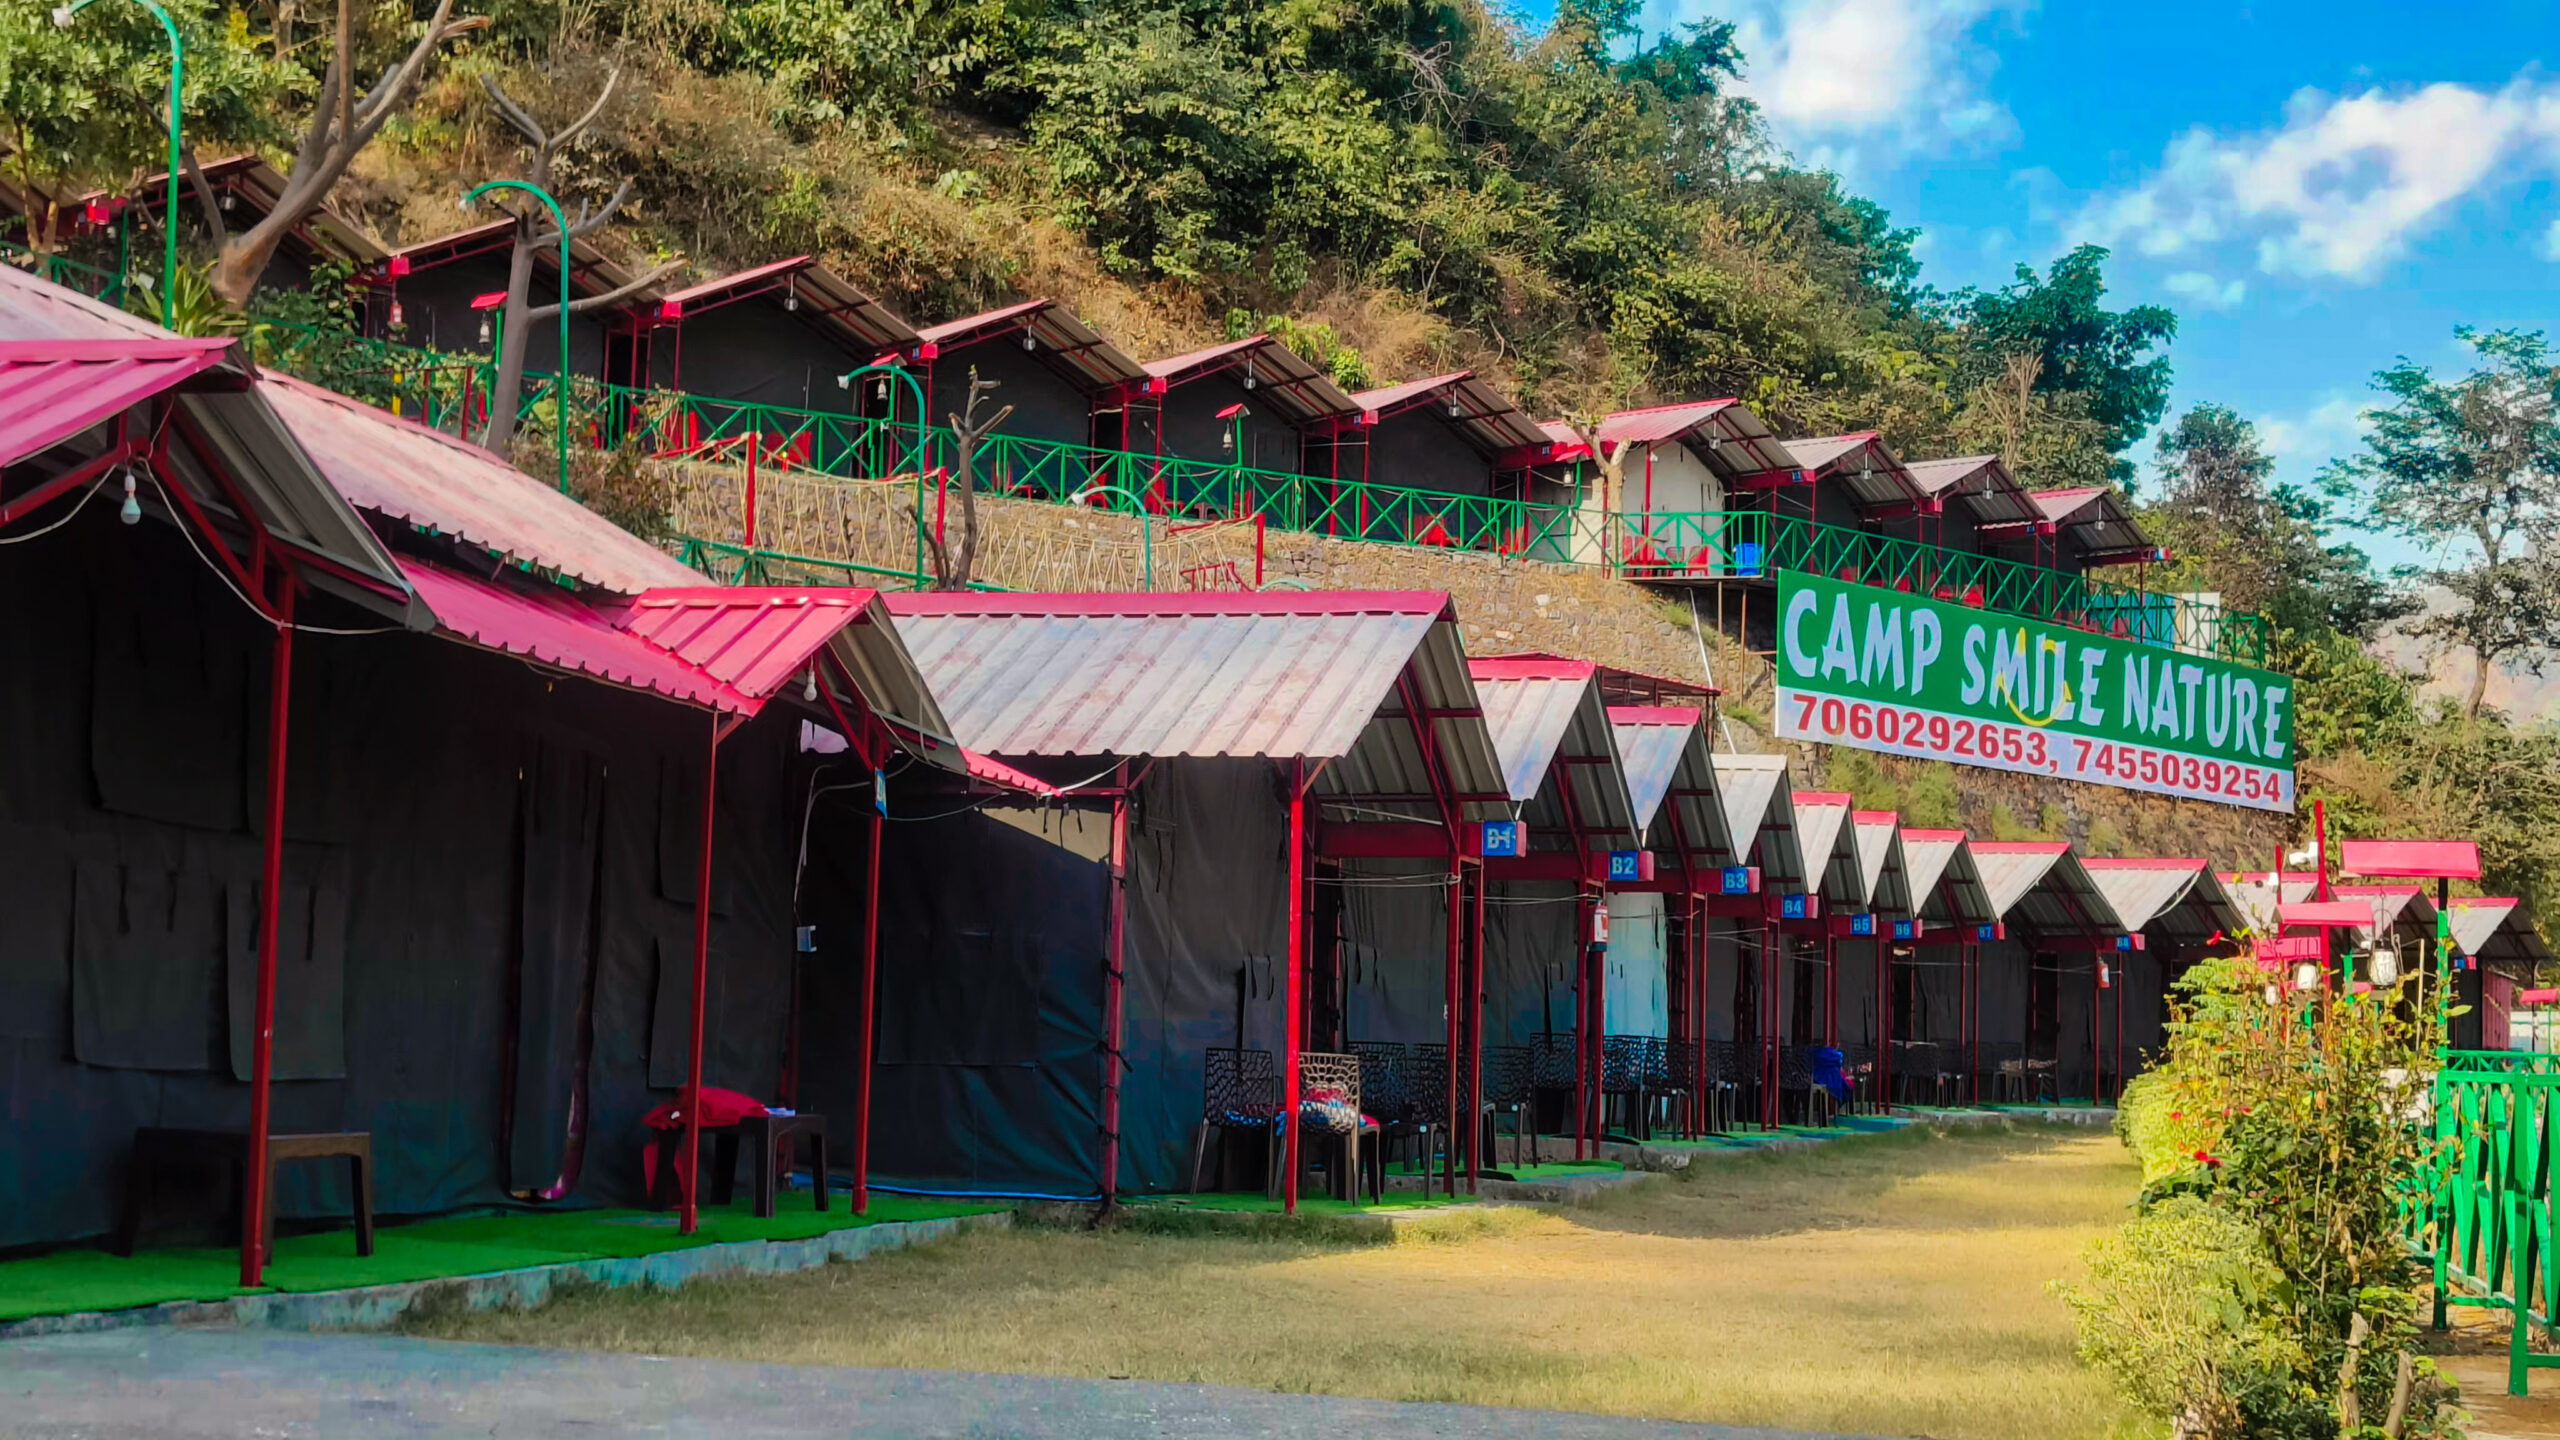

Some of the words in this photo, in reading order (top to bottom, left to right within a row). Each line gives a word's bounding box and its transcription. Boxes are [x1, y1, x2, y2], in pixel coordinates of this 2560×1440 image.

[1784, 589, 1941, 696] CAMP
[1961, 624, 2107, 726] SMILE
[2123, 653, 2286, 758] NATURE
[1793, 694, 2058, 773] 7060292653,
[2073, 739, 2280, 802] 7455039254
[1611, 857, 1634, 874] B2
[1725, 873, 1746, 888] B3
[1784, 899, 1801, 914] B4
